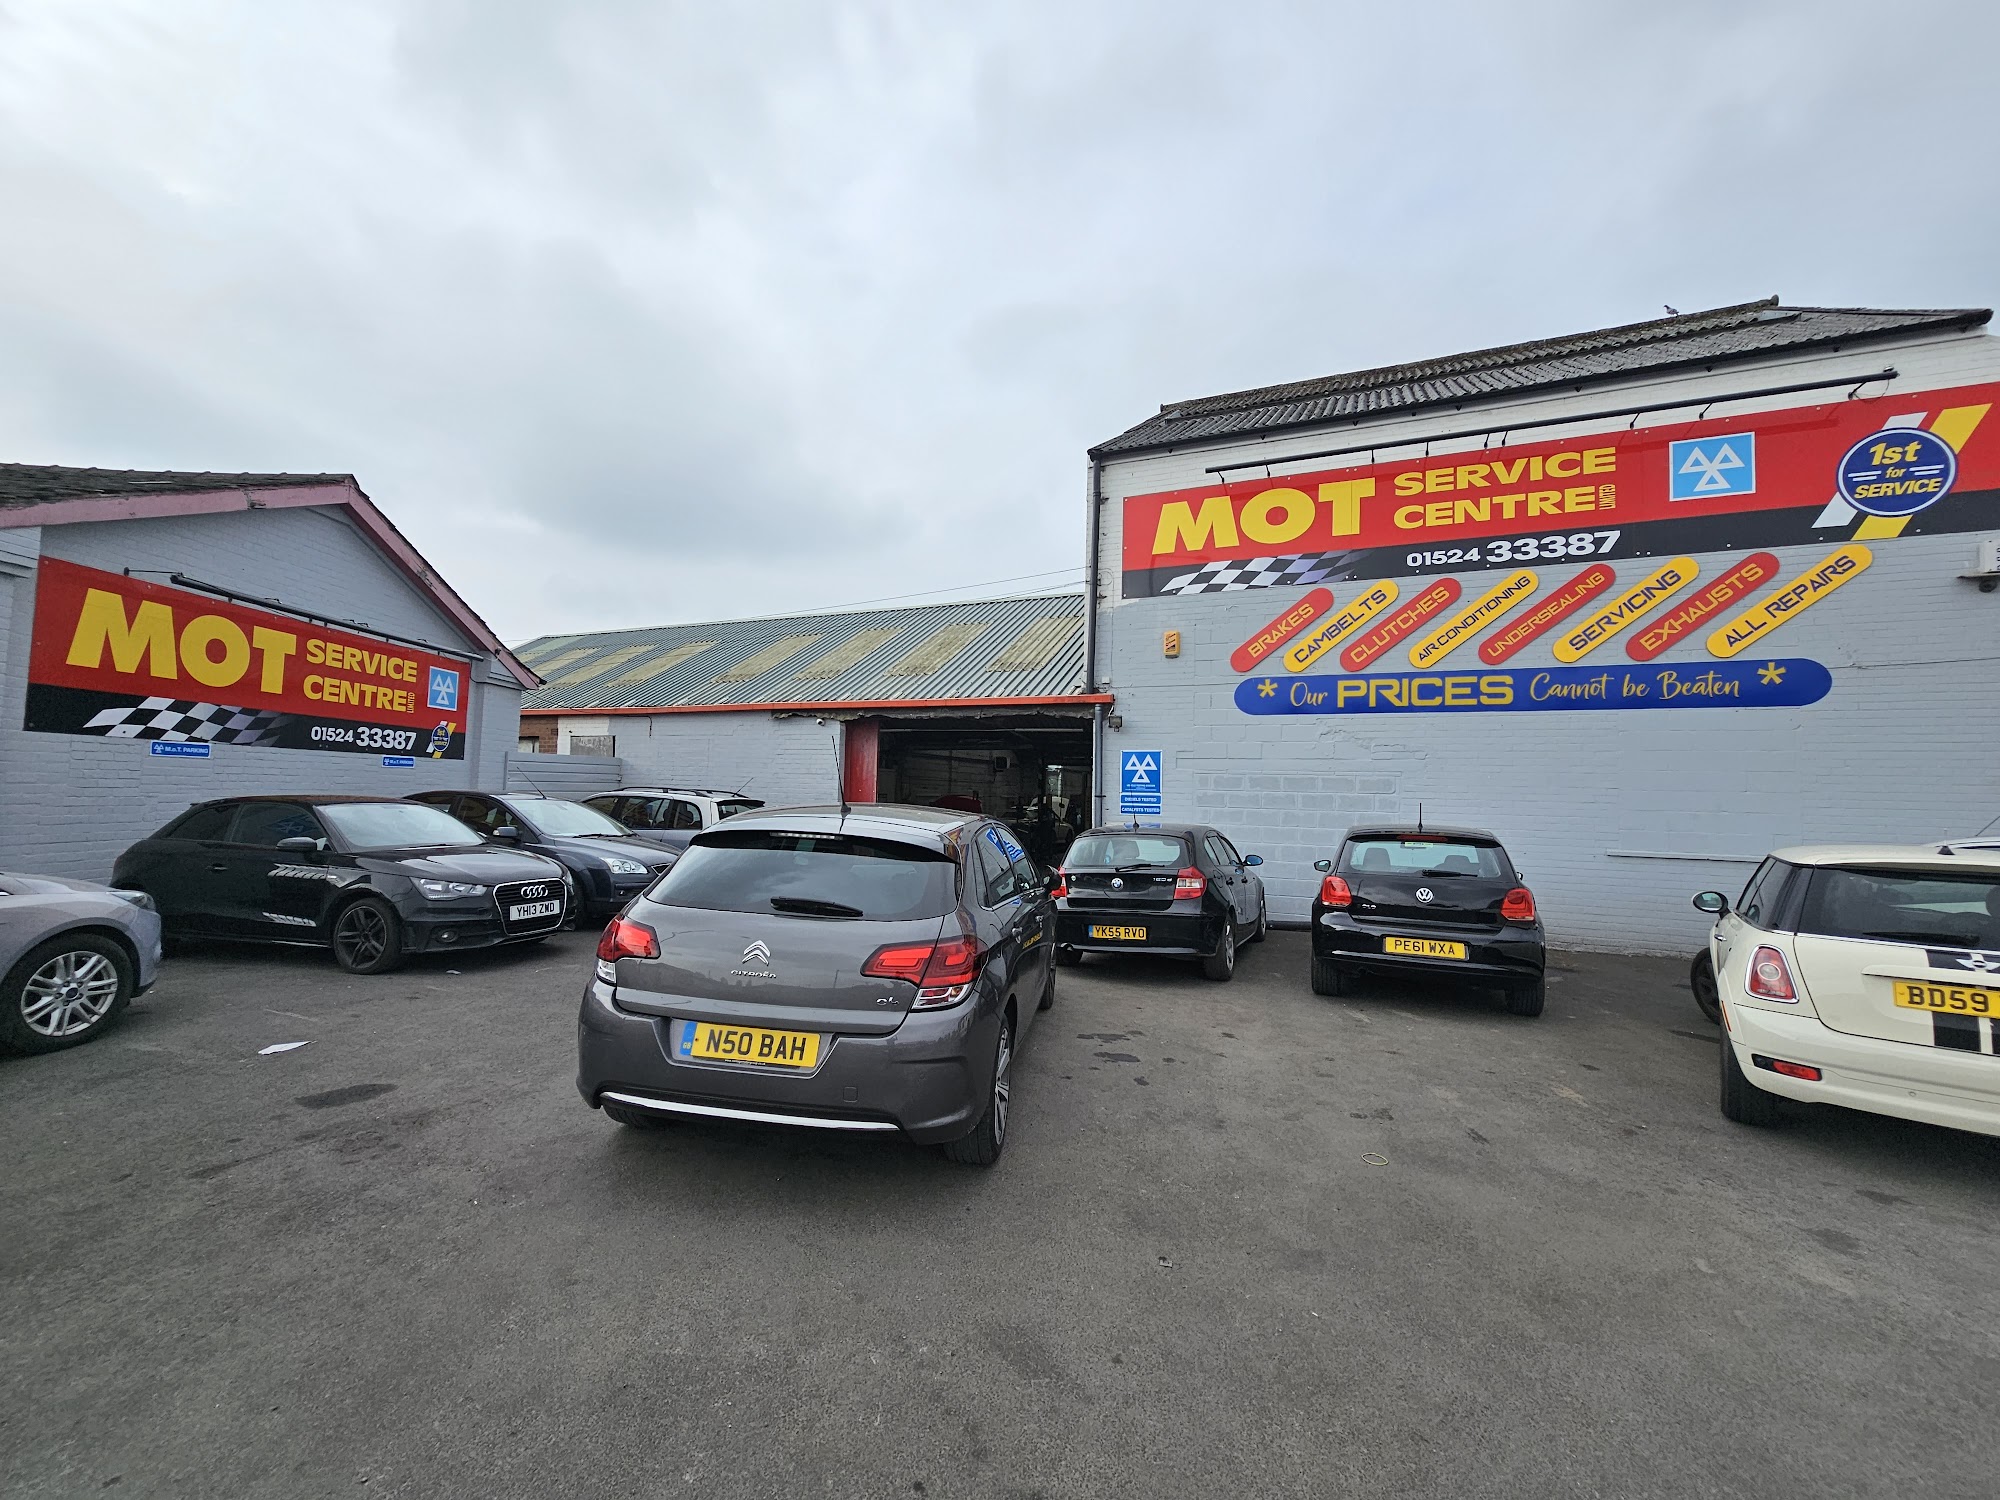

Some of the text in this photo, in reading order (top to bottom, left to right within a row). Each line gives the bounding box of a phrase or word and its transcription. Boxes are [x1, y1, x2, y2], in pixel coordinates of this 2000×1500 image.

[1394, 447, 1617, 497] SERVICE
[1869, 441, 1922, 466] 1st
[1885, 466, 1906, 478] for
[1393, 485, 1596, 530] CENTRE
[1854, 477, 1944, 499] SERVICE
[1151, 477, 1376, 555] MOT
[1406, 530, 1622, 568] 01524 33387
[1487, 571, 1605, 657] UNDERSEALING
[1568, 568, 1682, 652] SERVICING
[1639, 562, 1764, 652] EXHAUSTS
[1724, 554, 1857, 649] ALL REPAIRS
[65, 587, 297, 696] MOT
[1248, 603, 1315, 658] BRAKES
[1293, 589, 1388, 664] CAMBELTS
[1349, 586, 1450, 664] CLUTCHES
[306, 638, 418, 683] SERVICE
[303, 674, 407, 712] CENTRE
[1289, 671, 1740, 708] Our PRICES Cannot be Beaten
[311, 726, 417, 751] 01524 33387
[1095, 926, 1145, 939] YK55 RVO
[1394, 939, 1455, 956] PE61 WXA
[1906, 985, 1989, 1013] BD59
[705, 1028, 807, 1062] N50 BAH
